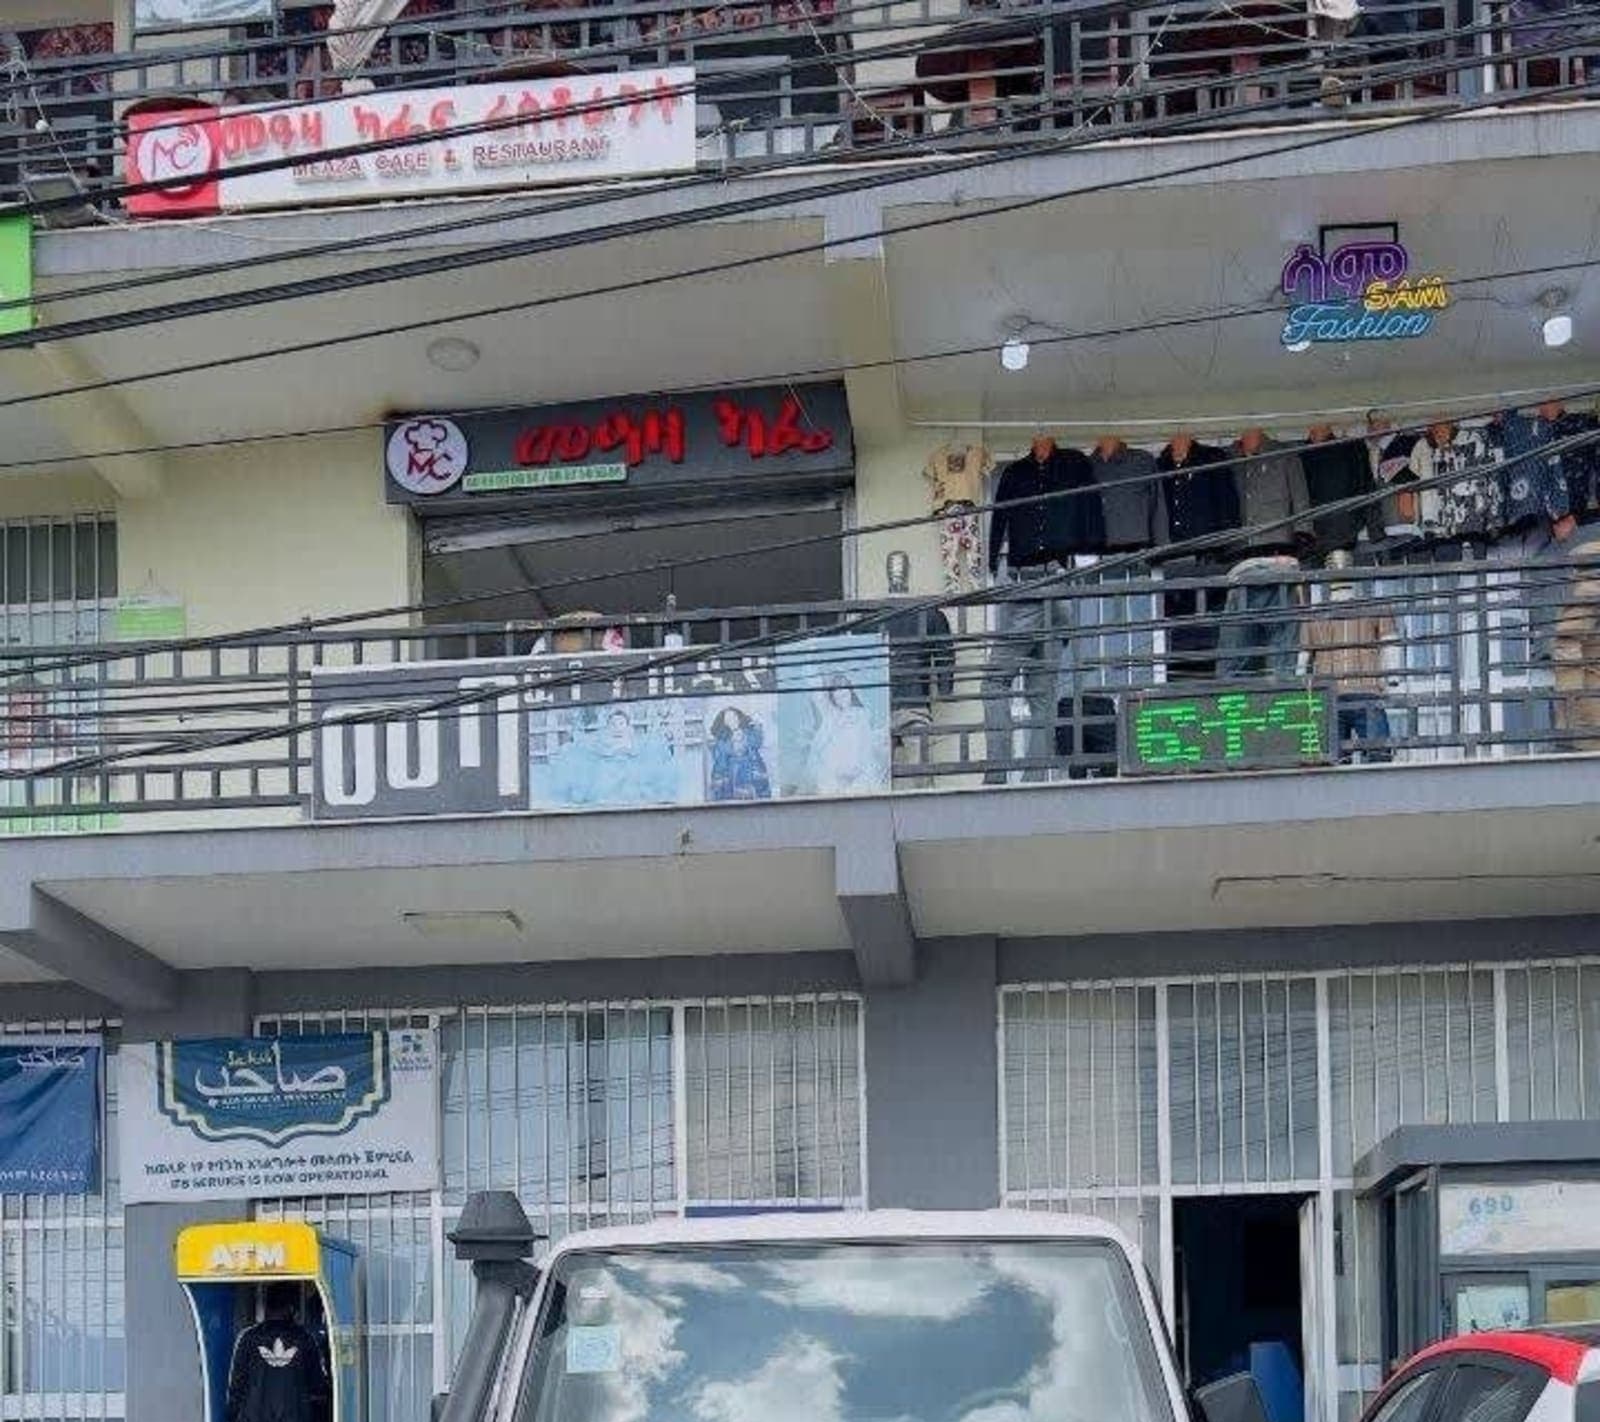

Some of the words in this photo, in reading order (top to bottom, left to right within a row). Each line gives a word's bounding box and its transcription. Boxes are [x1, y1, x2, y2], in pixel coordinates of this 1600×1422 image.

[375, 152, 428, 171] CAFE
[472, 136, 608, 161] RESTAURANT
[1281, 302, 1431, 344] Fashion
[210, 1243, 286, 1272] ATM
